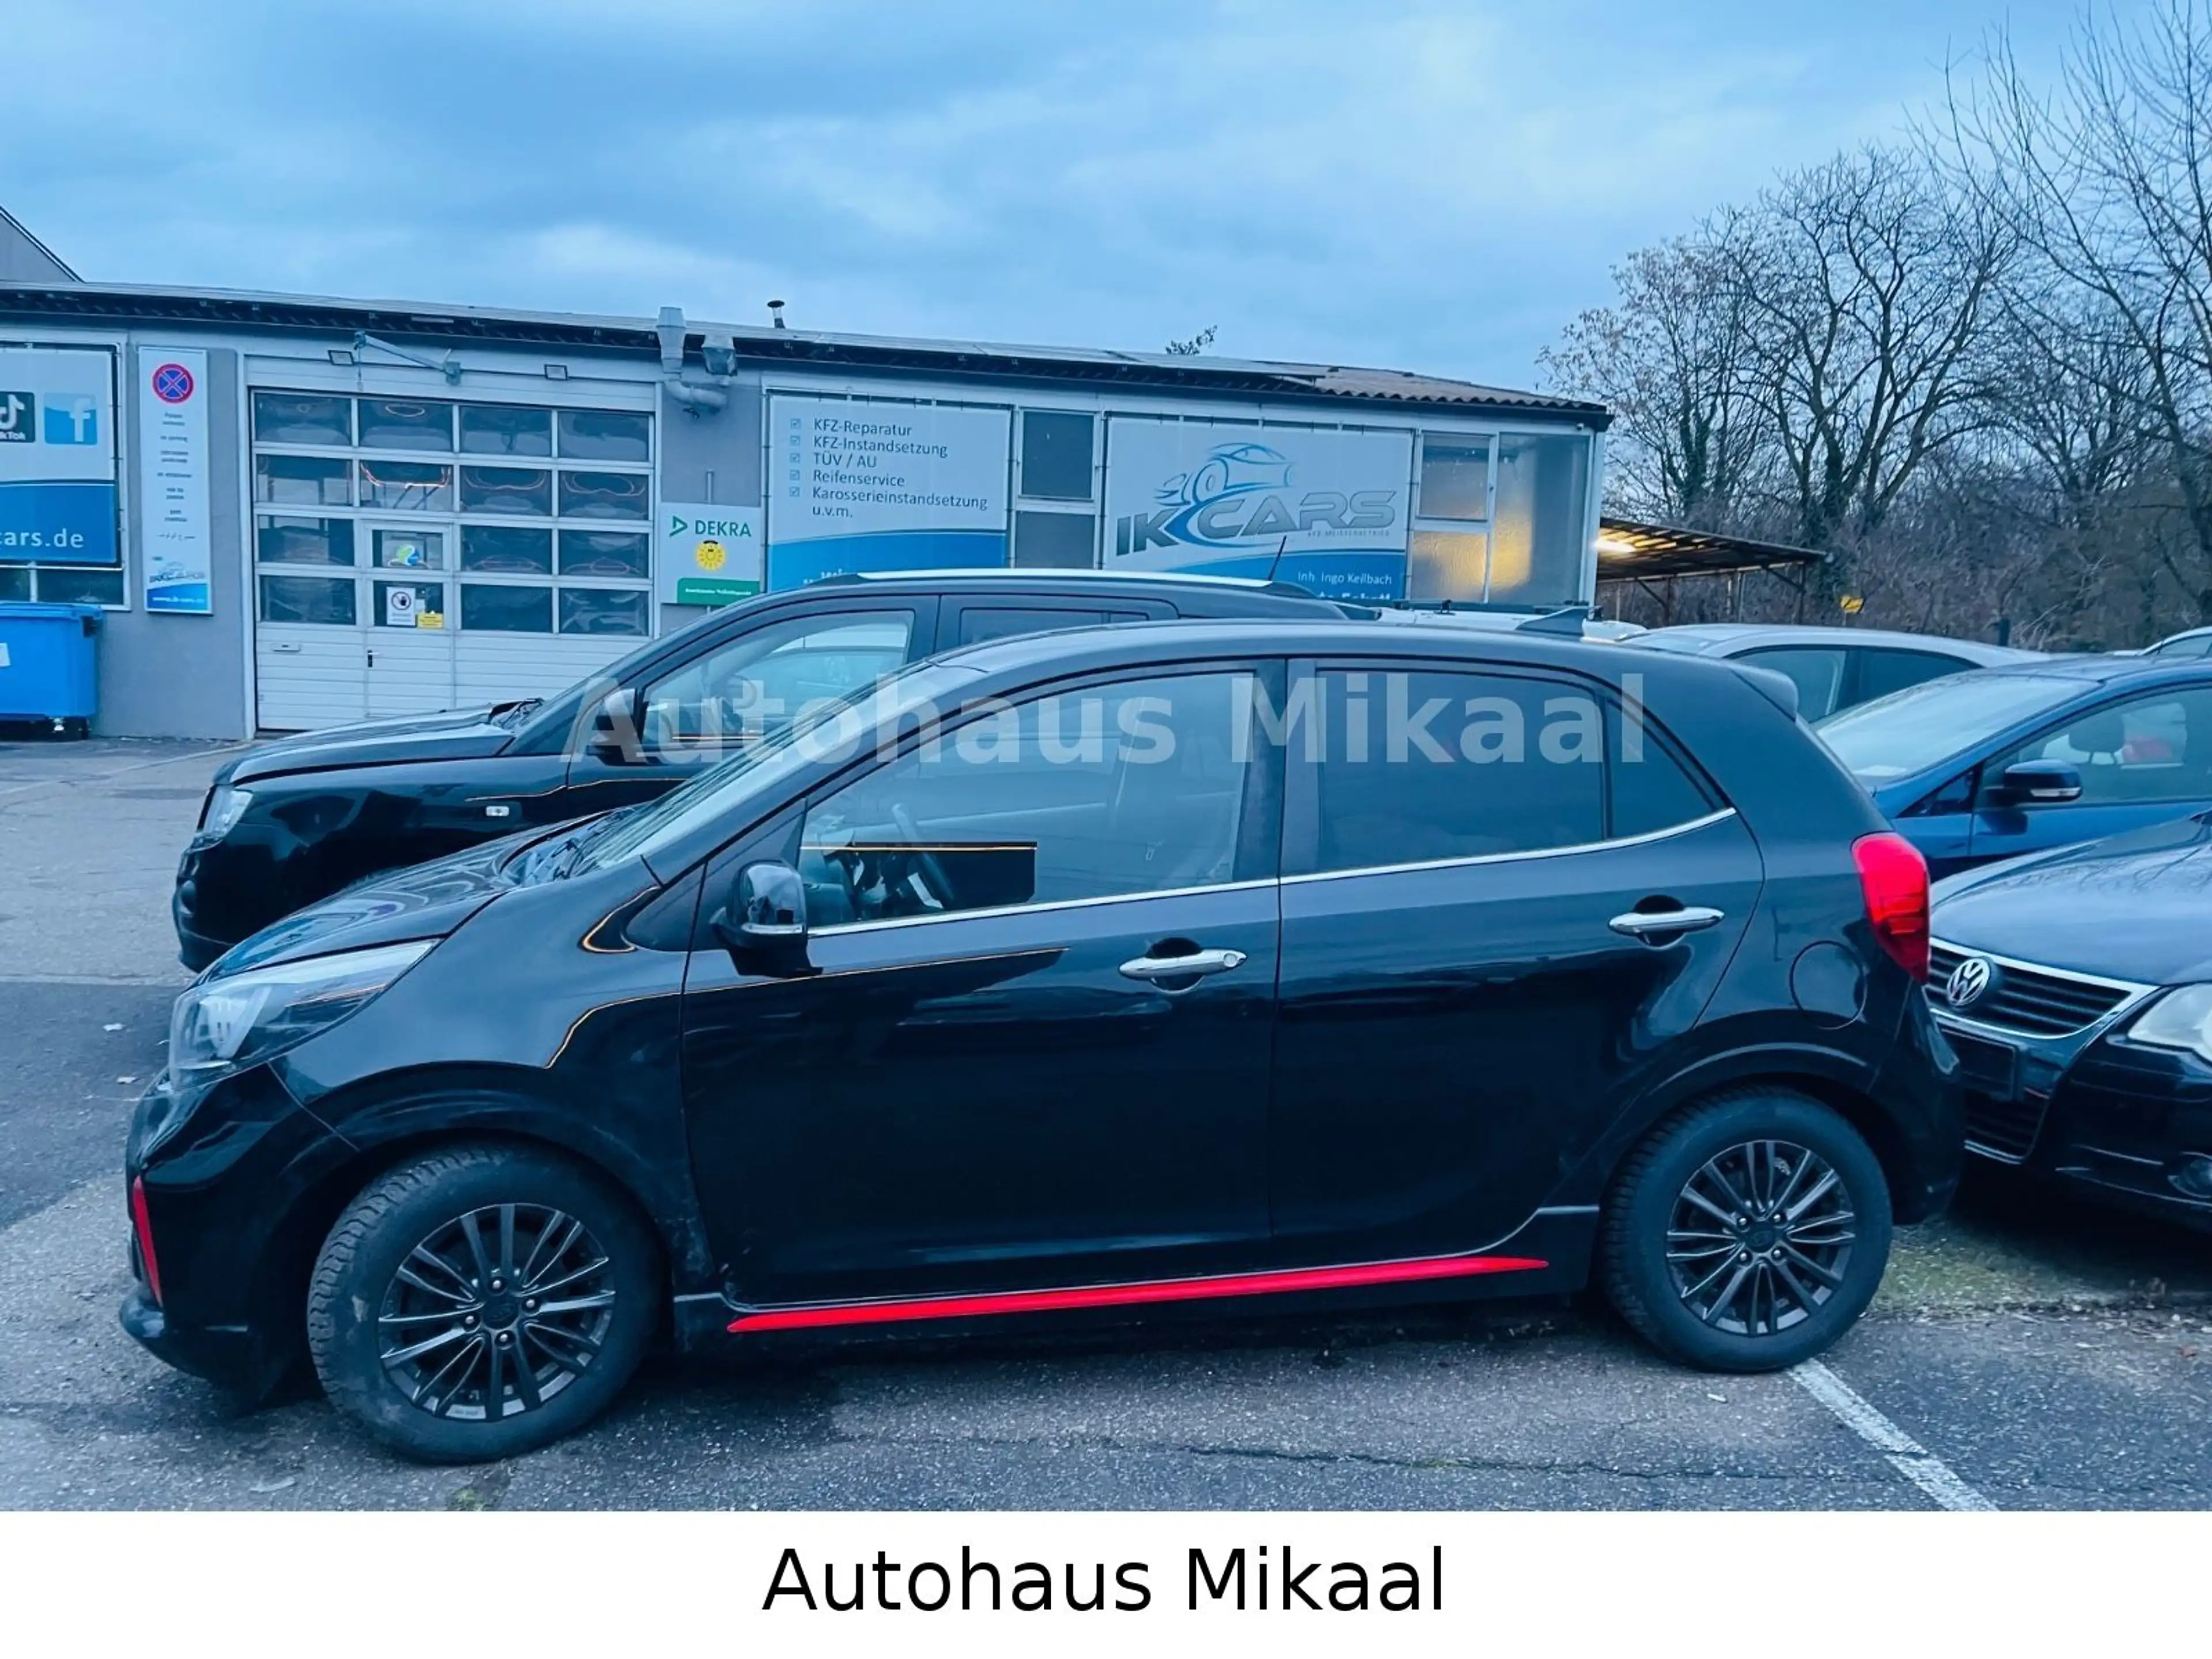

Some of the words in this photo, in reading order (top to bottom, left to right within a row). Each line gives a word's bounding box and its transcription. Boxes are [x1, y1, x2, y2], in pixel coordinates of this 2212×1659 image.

[814, 418, 912, 436] KFZ-Reparatur
[814, 435, 948, 458] KFZ-Instandsetzung
[813, 450, 842, 465] TÜV
[846, 453, 853, 469] /
[857, 456, 877, 468] AU
[813, 469, 905, 487] Reifenservice
[812, 487, 988, 511] Karosserieinstandsetzung
[812, 506, 853, 517] u.v.m.
[1196, 490, 1397, 540] CARS
[695, 520, 752, 537] DEKRA
[0, 528, 84, 548] ars.de
[1321, 571, 1344, 585] Ingo
